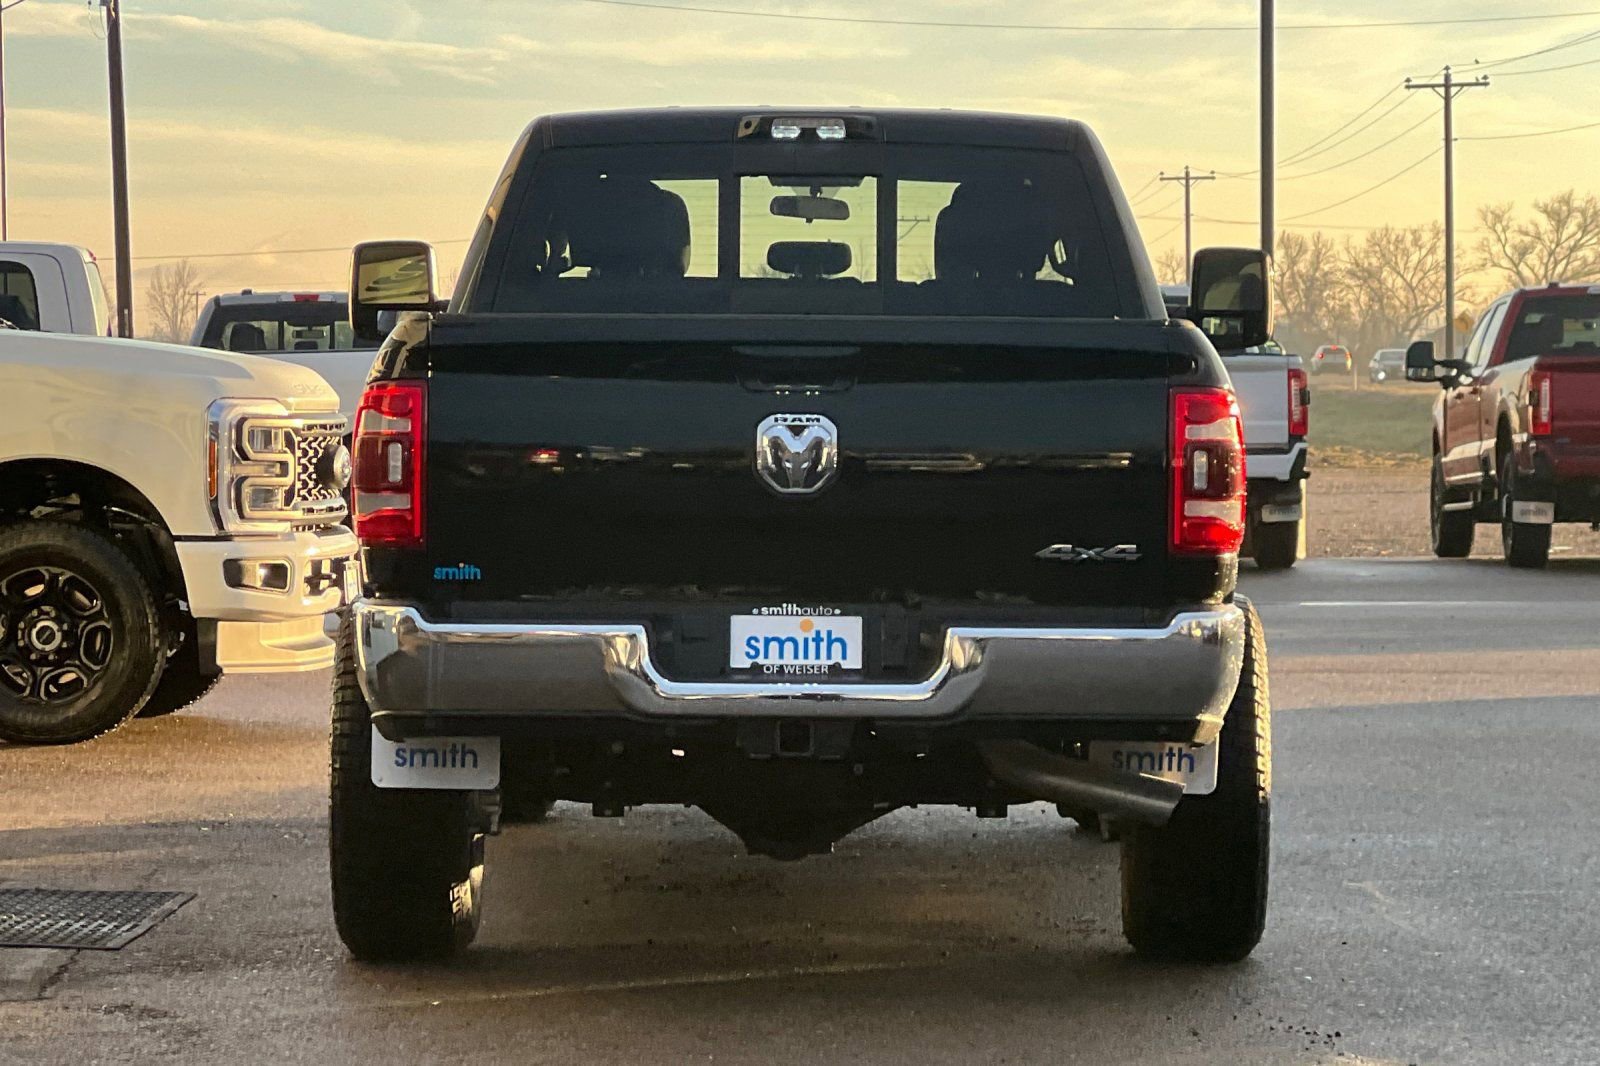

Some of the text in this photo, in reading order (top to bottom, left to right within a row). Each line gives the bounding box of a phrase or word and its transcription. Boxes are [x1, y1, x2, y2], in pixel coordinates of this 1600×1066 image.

[433, 562, 481, 580] smith
[744, 618, 848, 661] smith
[763, 664, 829, 674] OF WEISER
[394, 742, 478, 769] smith
[1112, 744, 1195, 773] smith
